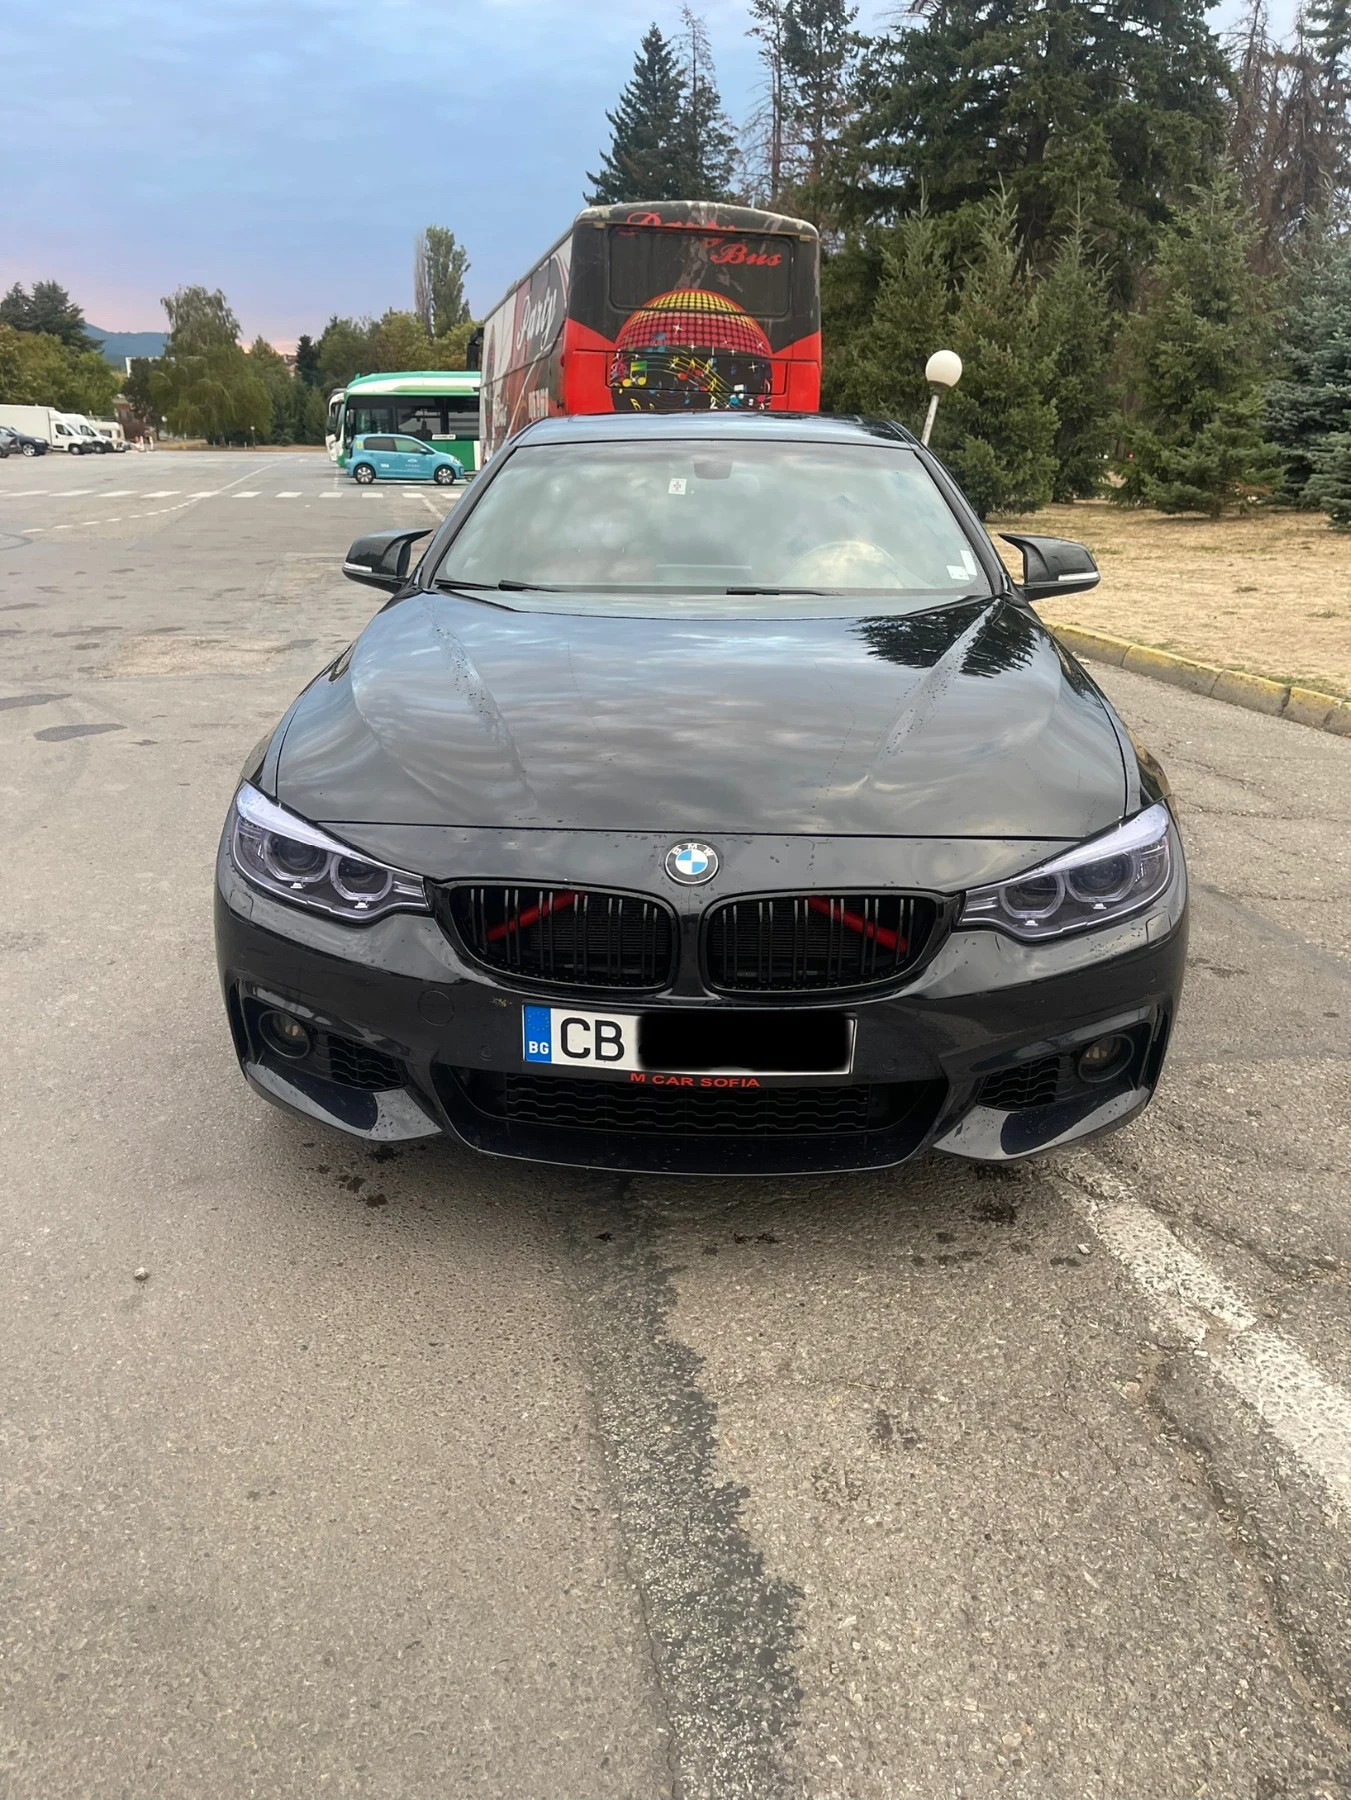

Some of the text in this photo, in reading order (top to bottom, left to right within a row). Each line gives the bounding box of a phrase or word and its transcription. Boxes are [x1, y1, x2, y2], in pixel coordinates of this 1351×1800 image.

[710, 243, 782, 266] Bus
[516, 286, 558, 351] Party
[671, 843, 714, 857] BMW
[528, 1041, 549, 1055] BG
[560, 1017, 625, 1062] CB
[630, 1072, 760, 1088] M CAR SOFIA
